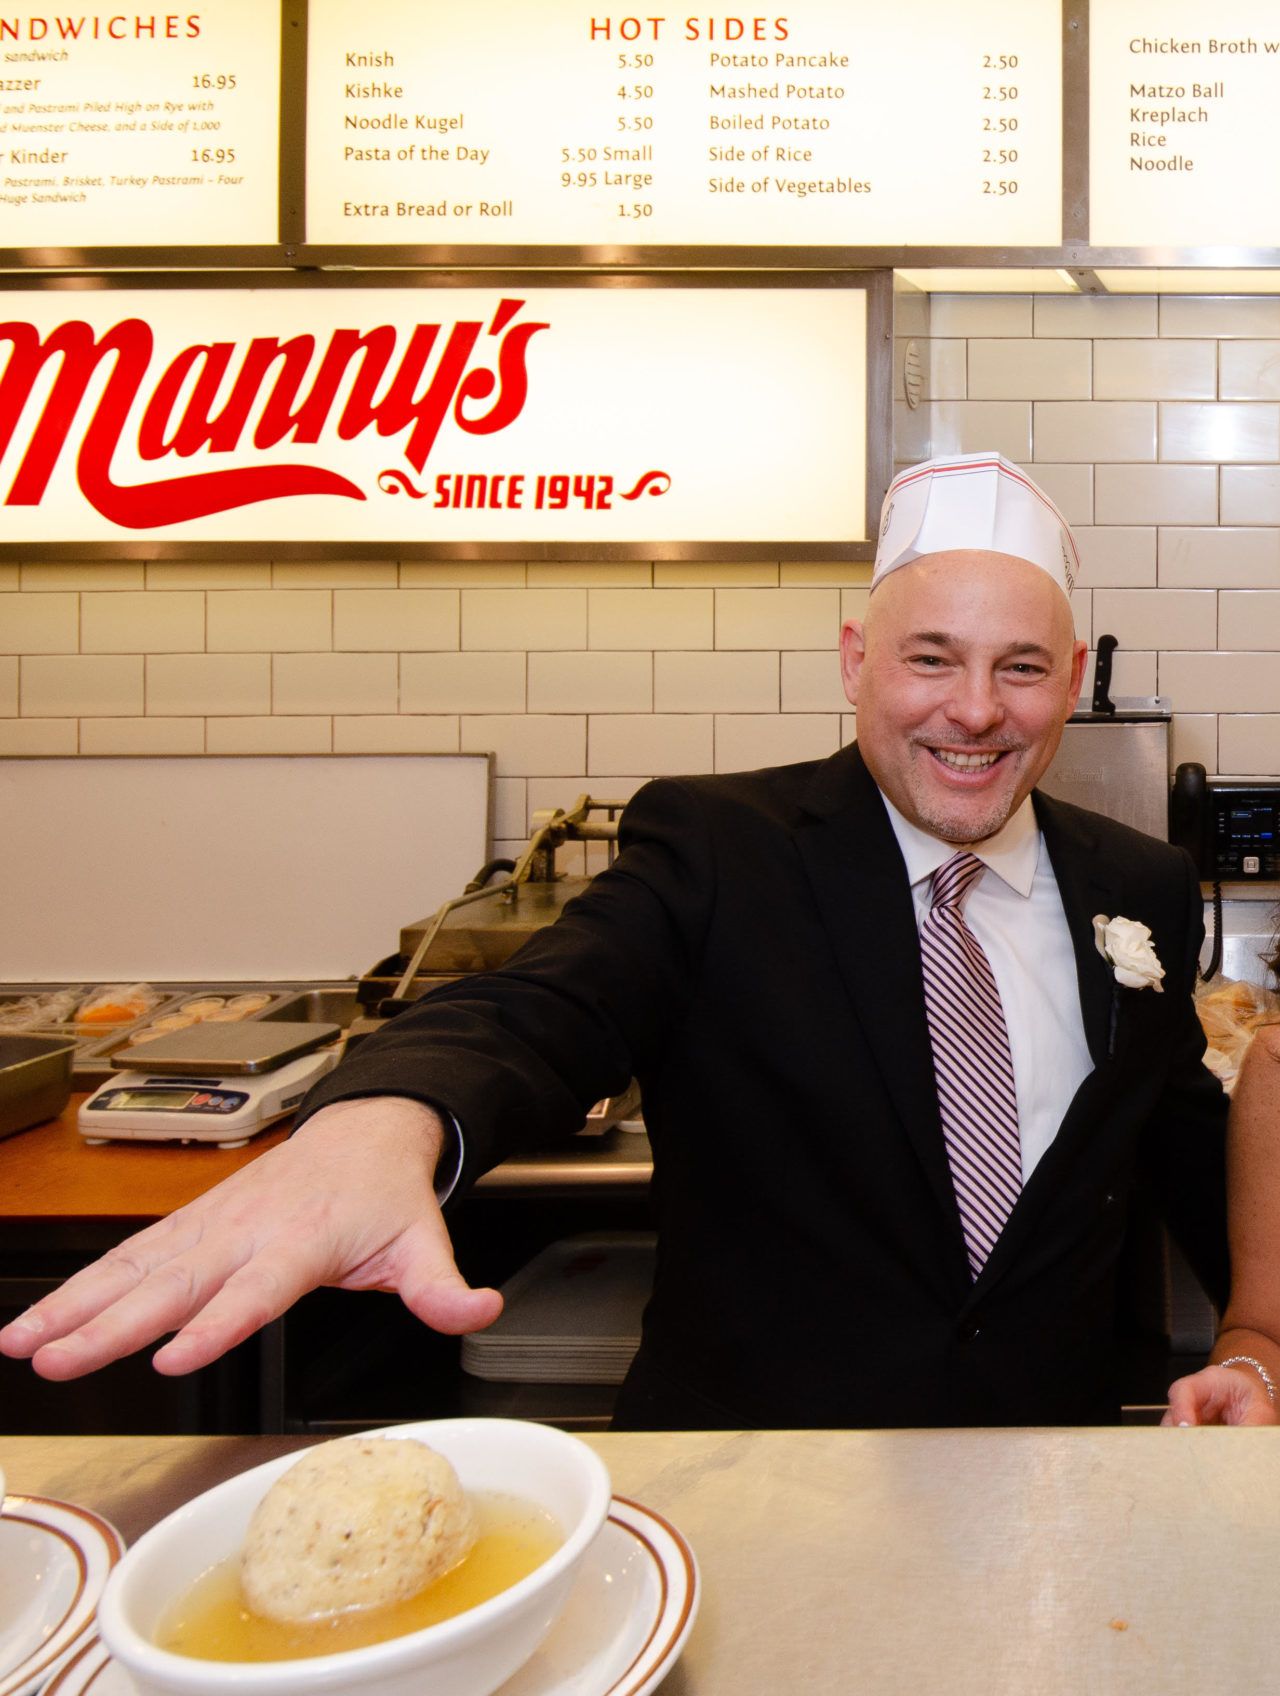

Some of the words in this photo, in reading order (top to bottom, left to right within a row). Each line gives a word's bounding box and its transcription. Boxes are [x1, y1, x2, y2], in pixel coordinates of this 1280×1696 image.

[0, 15, 202, 41] NDWICHES
[590, 17, 665, 41] HOT
[685, 16, 788, 41] SIDES
[1129, 38, 1201, 53] Chicken
[1209, 38, 1257, 53] Broth
[346, 51, 394, 67] Knish
[618, 54, 654, 69] 5.50
[710, 52, 768, 67] Potato
[775, 52, 848, 67] Pancake
[983, 55, 1018, 70] 2.50
[193, 73, 236, 89] 16.95
[344, 81, 403, 98] Kishke
[617, 85, 653, 100] 4.50
[710, 83, 778, 98] Mashed
[786, 84, 844, 99] Potato
[1130, 84, 1185, 98] Matzo
[1193, 82, 1223, 98] Ball
[344, 113, 408, 129] Noodle
[415, 113, 463, 134] Kugel
[618, 115, 653, 131] 5.50
[709, 114, 764, 129] Boiled
[771, 115, 830, 130] Potato
[1130, 106, 1207, 127] Kreplach
[1131, 132, 1166, 147] Rice
[9, 148, 68, 164] Kinder
[192, 148, 235, 164] 16.95
[344, 145, 390, 160] Pasta
[420, 144, 449, 160] the
[456, 145, 490, 165] Day
[561, 147, 597, 163] 5.50
[603, 144, 652, 161] Small
[709, 145, 745, 161] Side
[776, 146, 812, 161] Rice
[1130, 155, 1193, 171] Noodle
[560, 172, 597, 187] 9.95
[604, 171, 652, 190] Large
[709, 176, 745, 192] Side
[775, 177, 871, 198] Vegetables
[344, 201, 389, 216] Extra
[396, 200, 447, 216] Bread
[479, 200, 512, 216] Roll
[618, 203, 653, 220] 1.50
[0, 298, 551, 529] Manny's
[433, 474, 525, 508] SINCE
[534, 475, 613, 510] 1942
